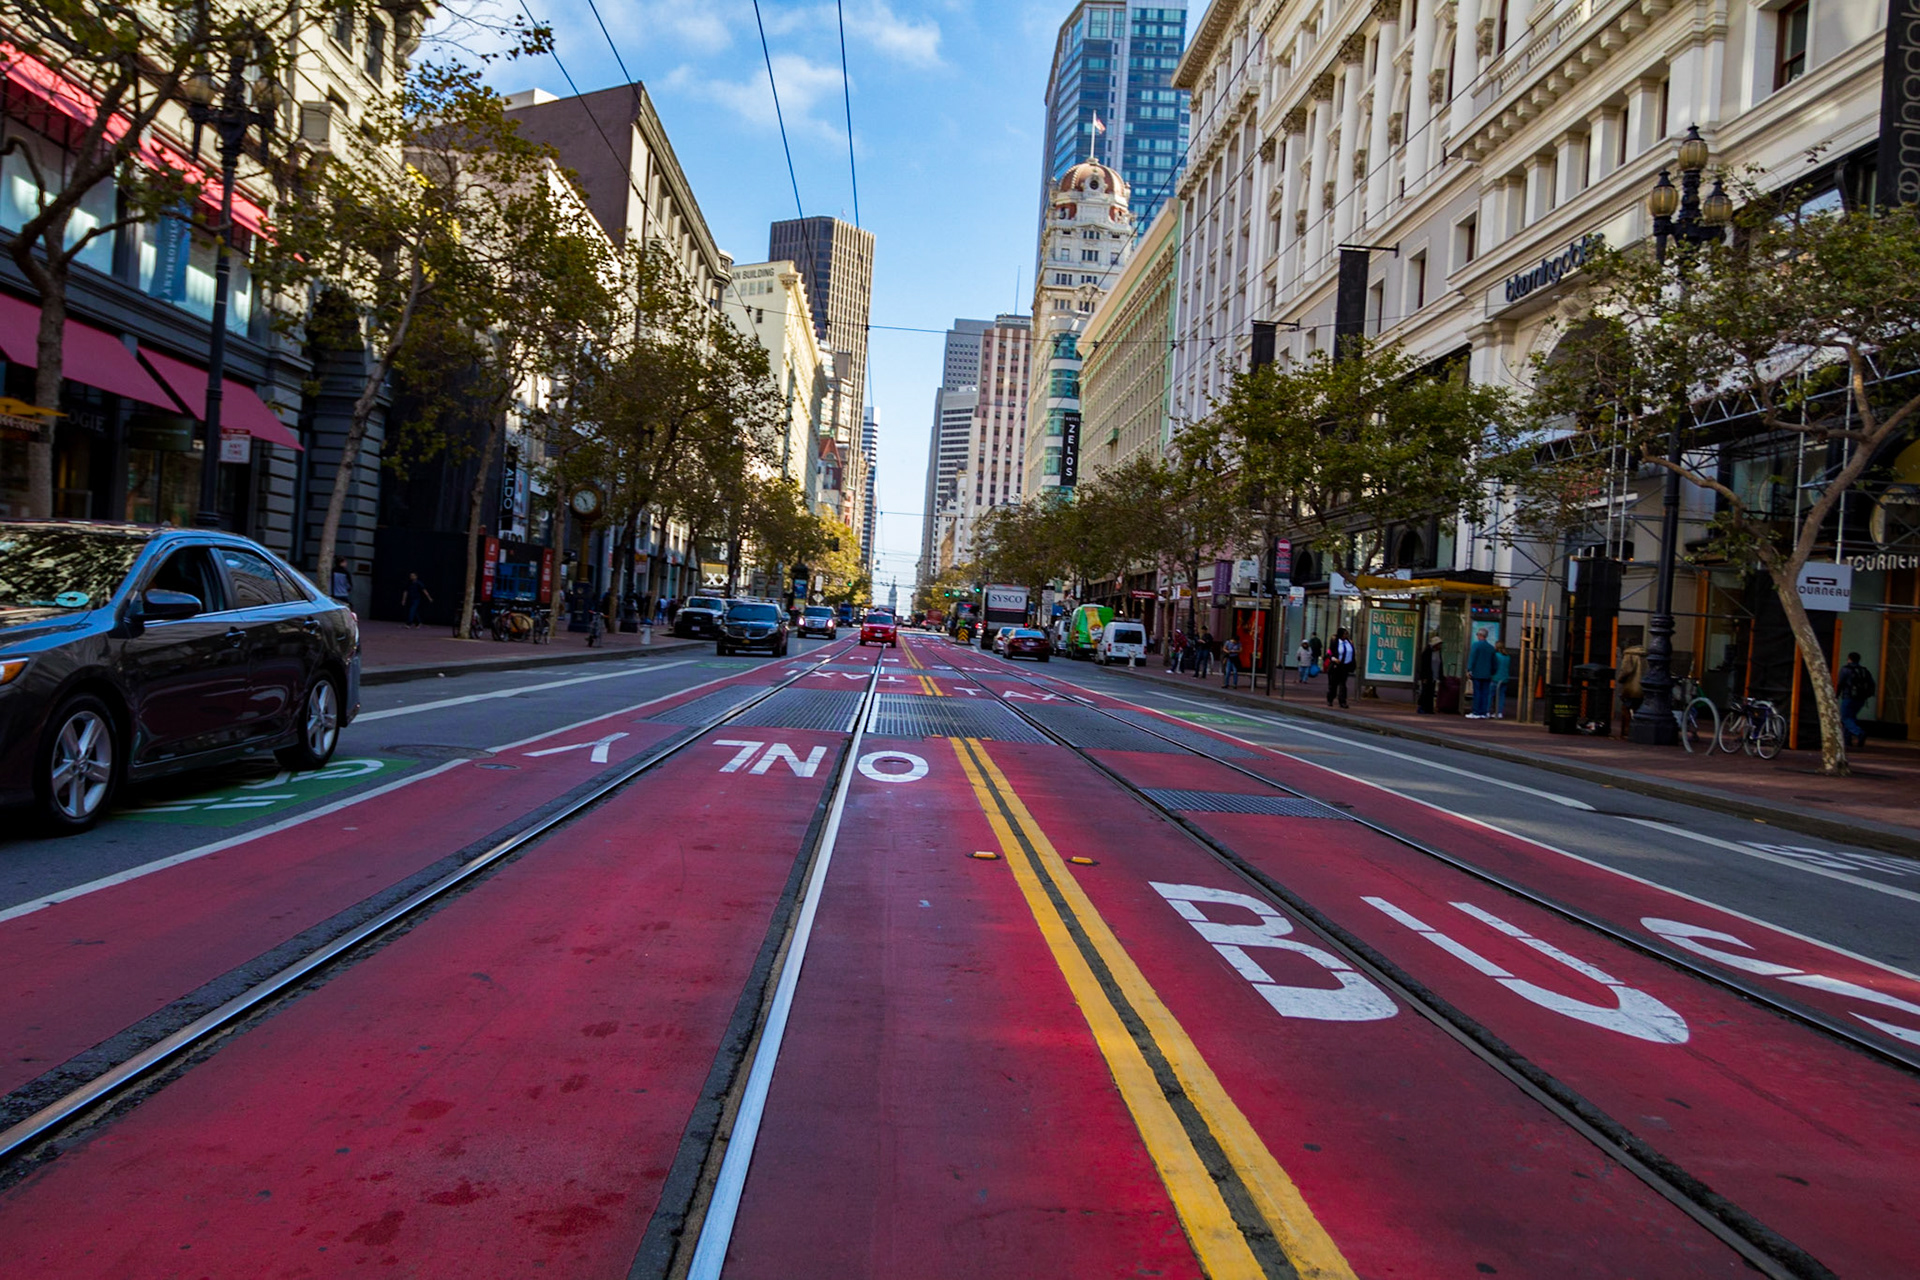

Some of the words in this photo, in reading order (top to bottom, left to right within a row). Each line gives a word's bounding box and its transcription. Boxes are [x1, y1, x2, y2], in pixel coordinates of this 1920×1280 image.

[162, 218, 179, 296] ANTHROPOLO
[742, 268, 775, 280] BUILDING
[1065, 424, 1076, 477] ZELOS
[503, 467, 515, 510] ALDO
[991, 594, 1023, 604] SYSCO
[1796, 585, 1850, 598] OURNEAU
[954, 686, 1095, 703] TAXI
[522, 732, 930, 783] ONLY
[1148, 880, 1920, 1046] BUS
